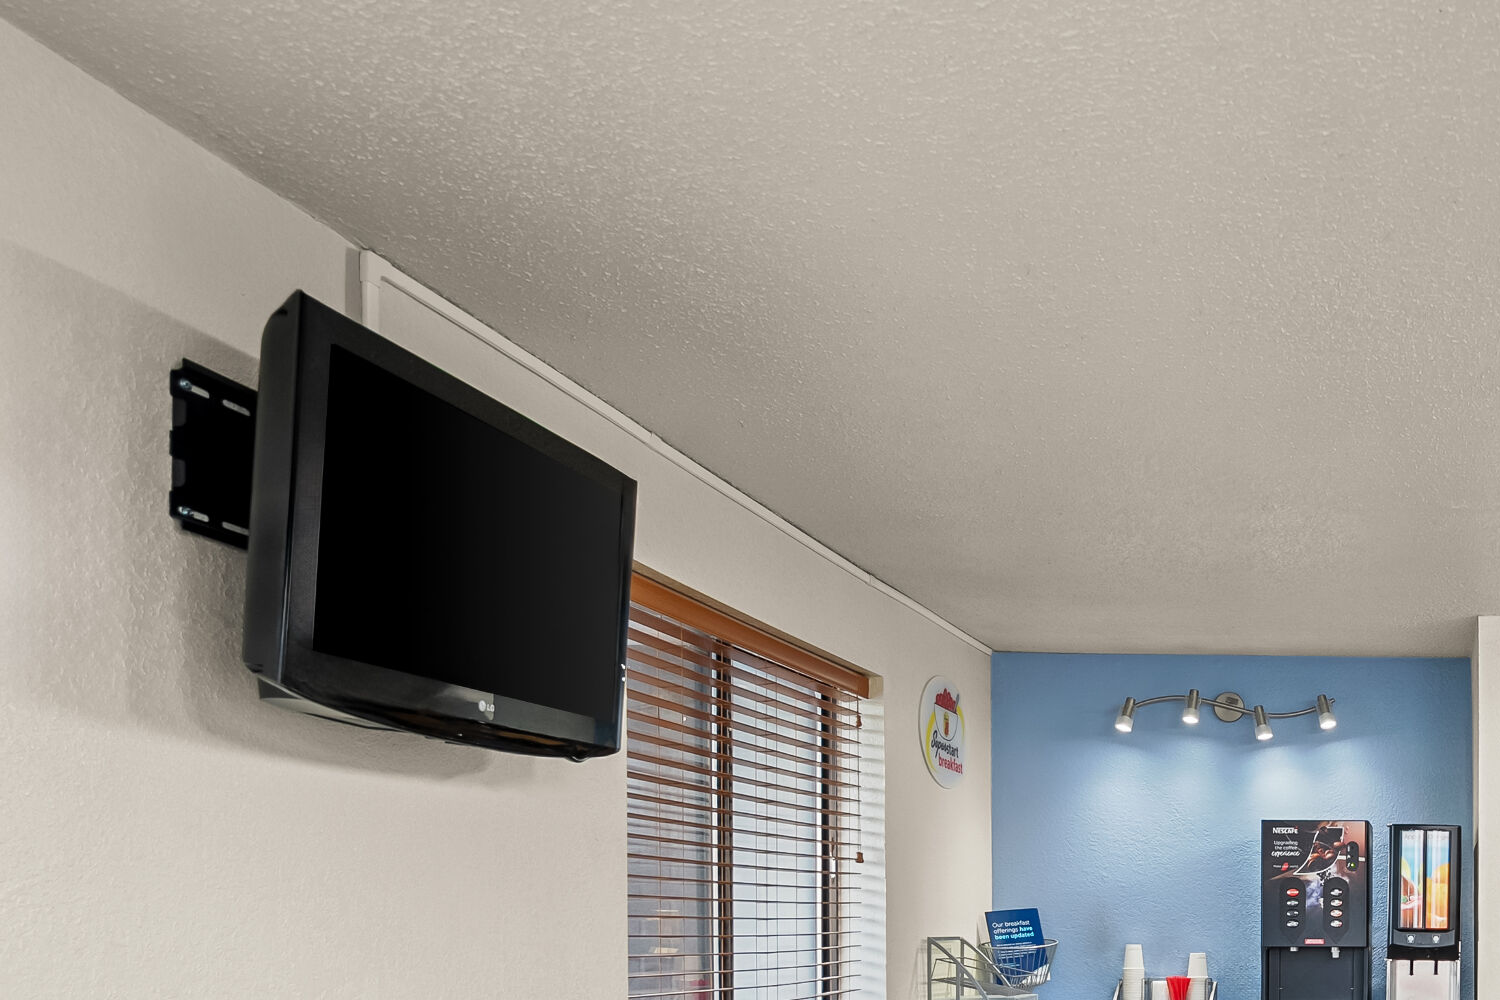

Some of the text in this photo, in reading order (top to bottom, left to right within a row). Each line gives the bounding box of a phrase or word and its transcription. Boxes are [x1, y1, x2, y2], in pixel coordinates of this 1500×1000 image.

[931, 730, 959, 758] Superstart
[938, 753, 963, 775] breakfast
[993, 926, 1019, 934] offerings
[1010, 931, 1035, 940] updated
